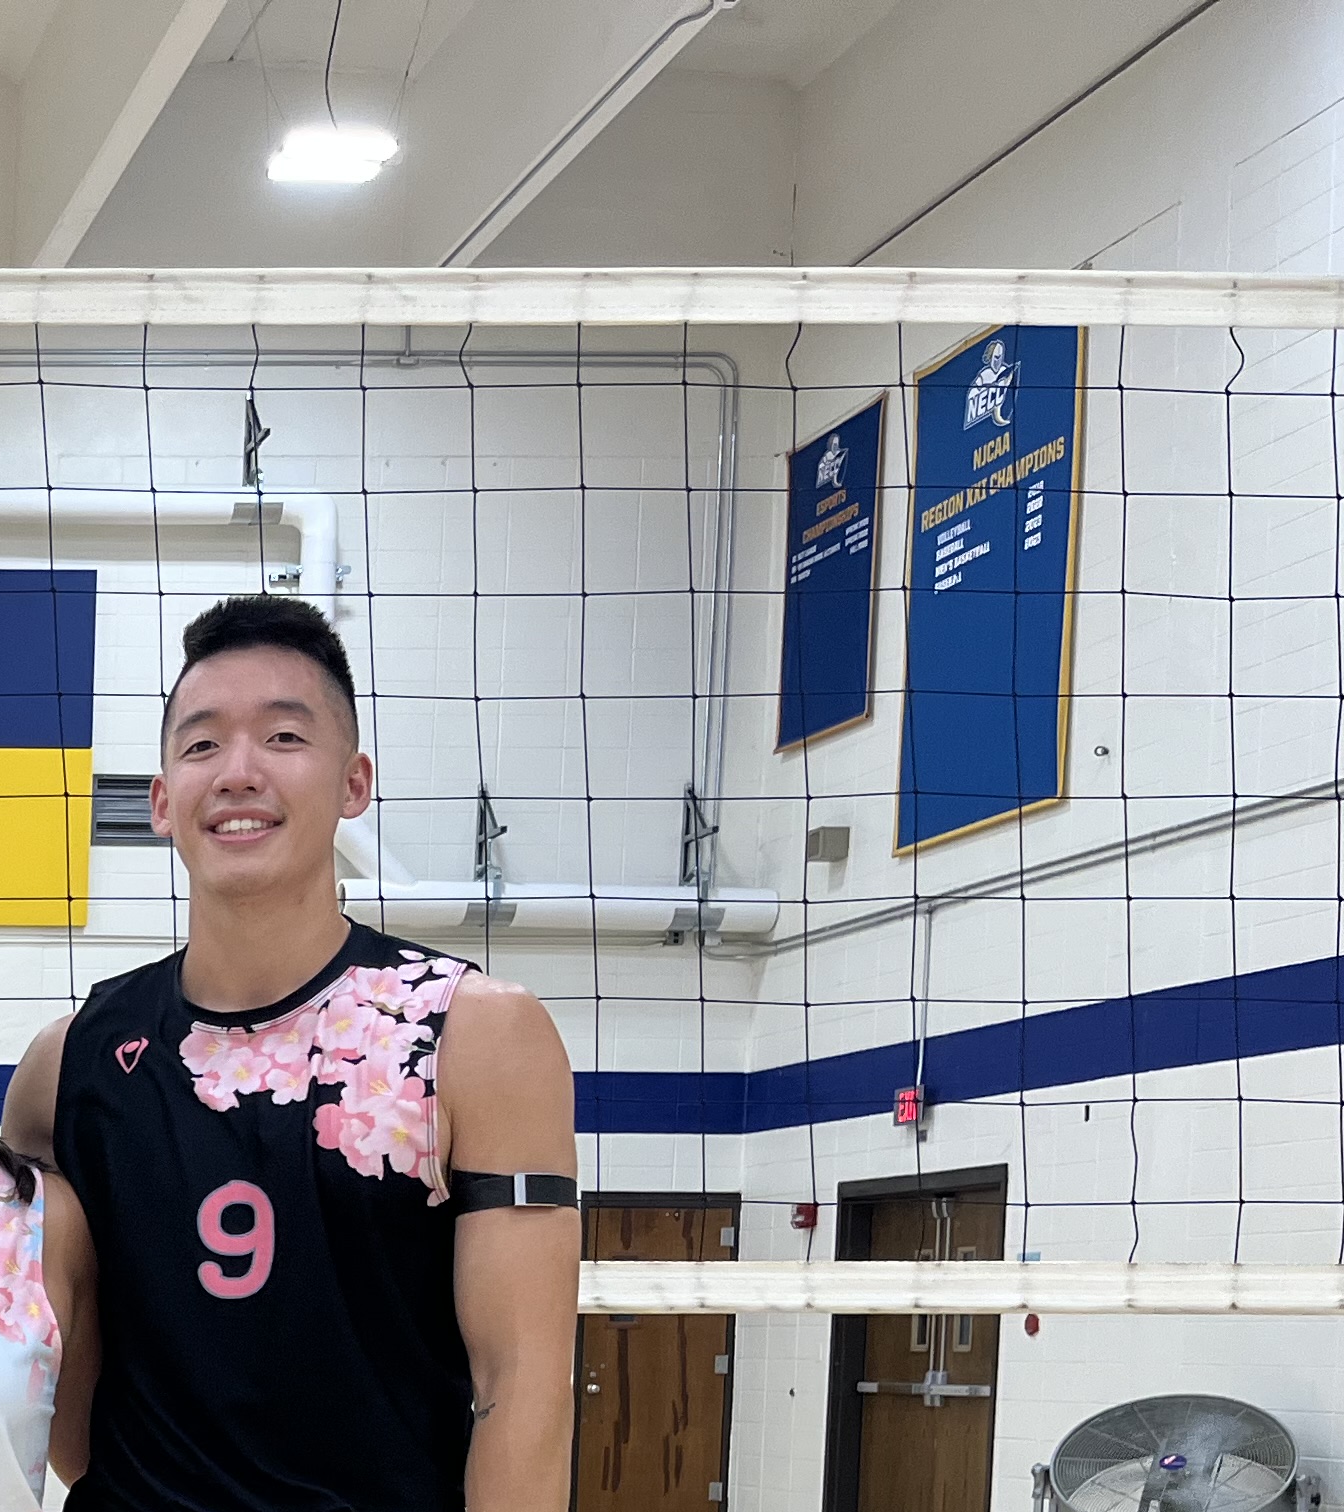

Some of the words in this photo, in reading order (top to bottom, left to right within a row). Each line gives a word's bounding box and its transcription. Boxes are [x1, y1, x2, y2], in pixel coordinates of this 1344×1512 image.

[921, 491, 964, 533] REGION
[966, 477, 989, 509] XXI
[990, 436, 1065, 496] CHAMPIONS
[973, 431, 1010, 471] NJCAA
[196, 1179, 275, 1299] 9
